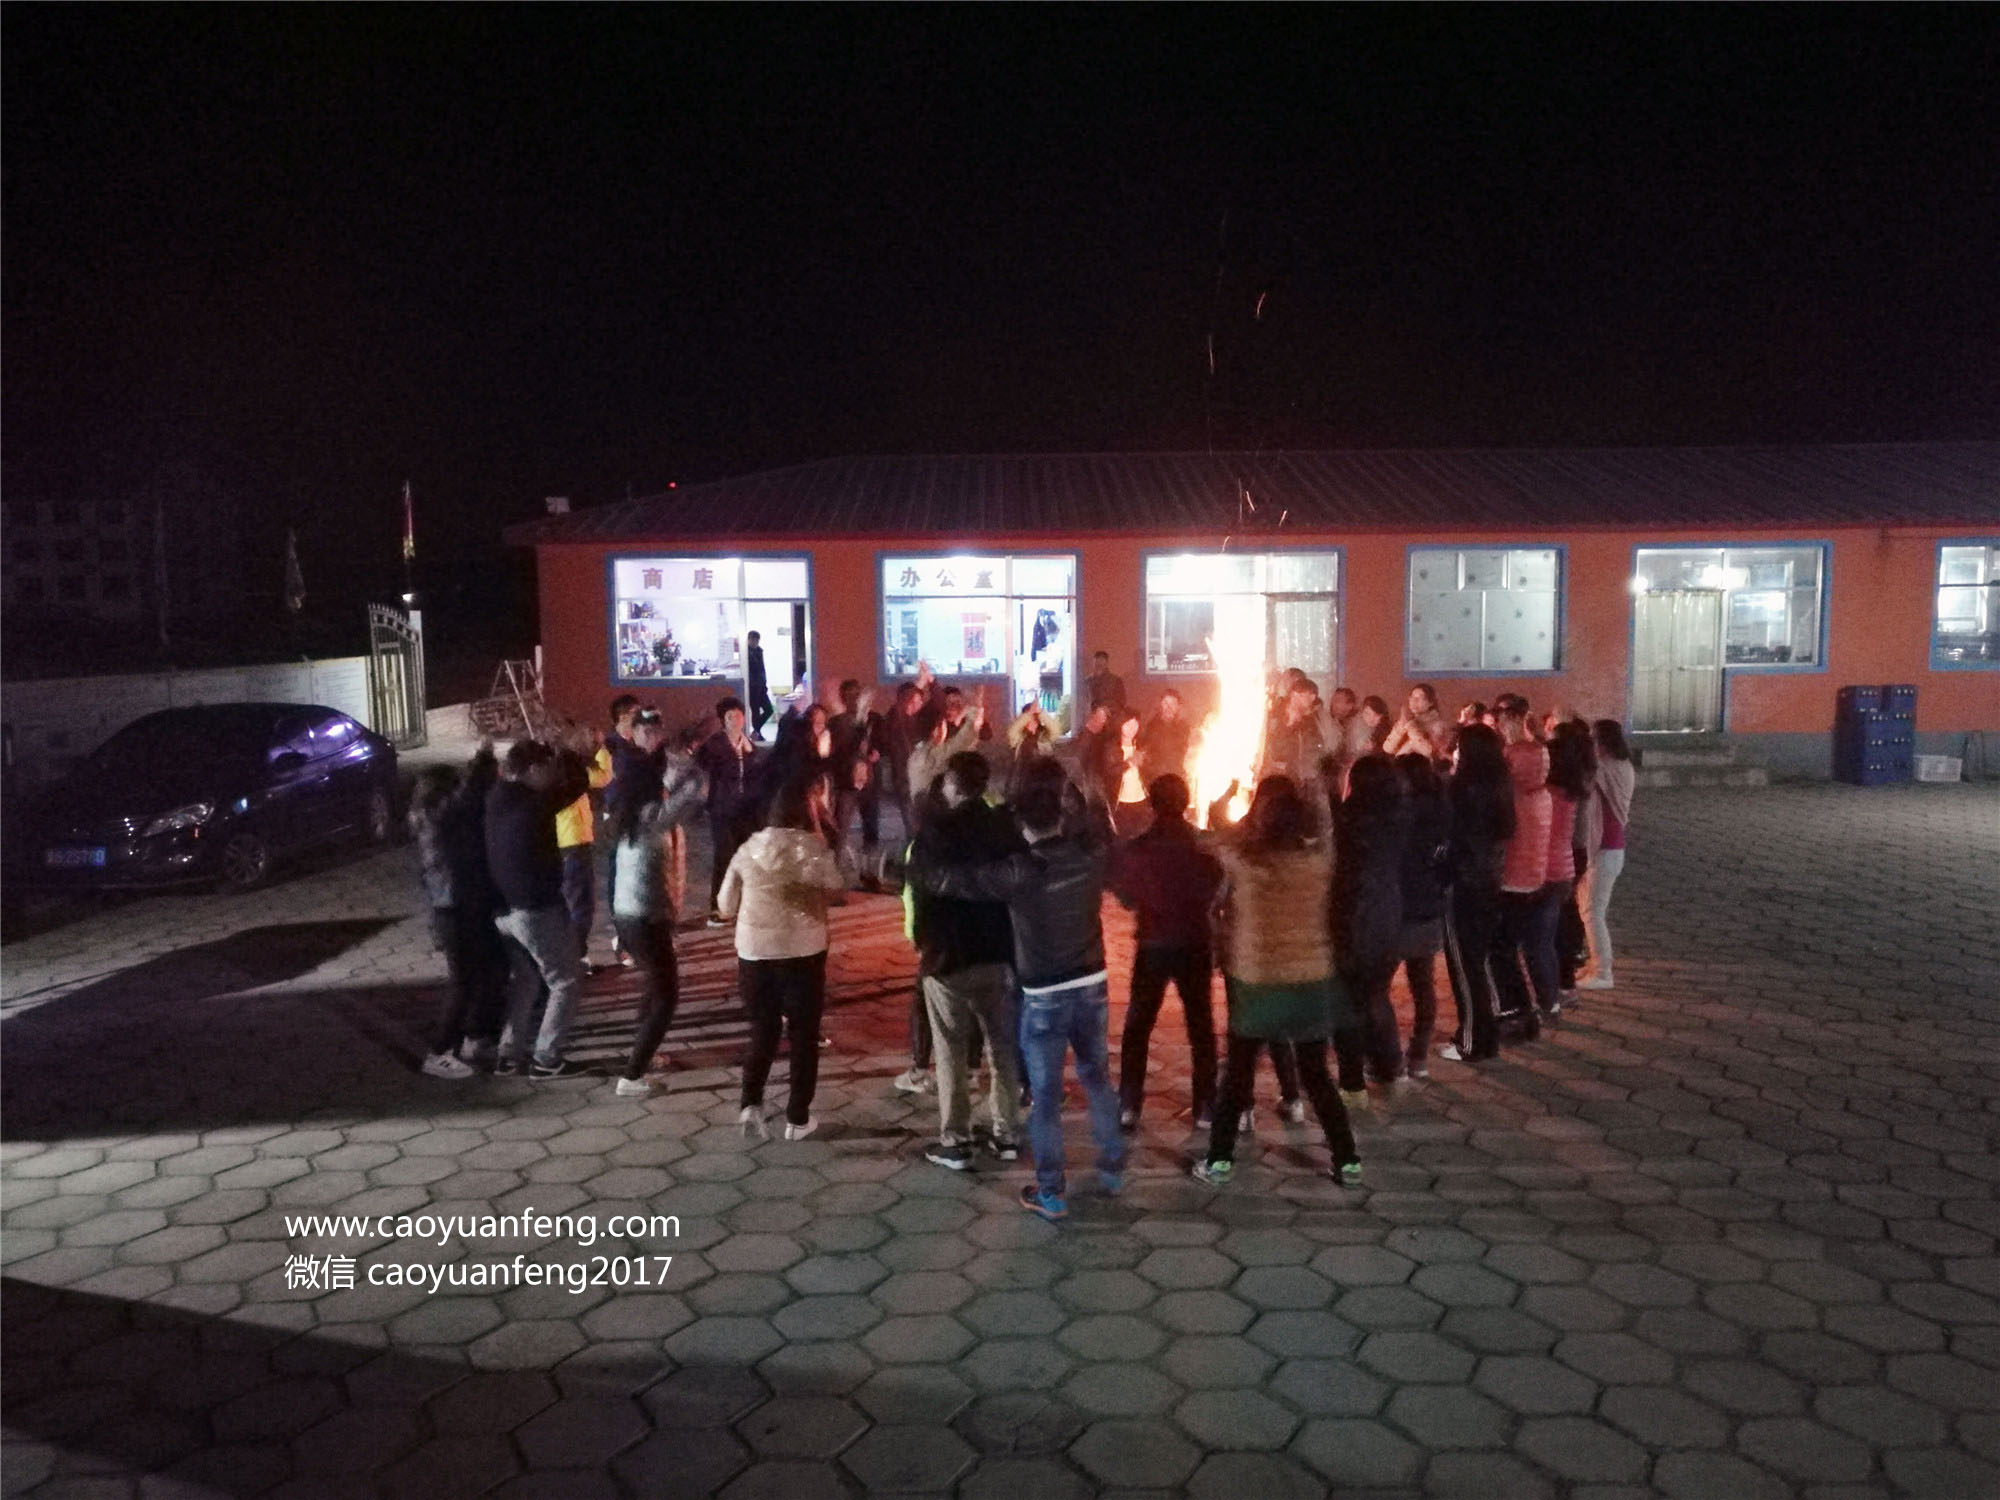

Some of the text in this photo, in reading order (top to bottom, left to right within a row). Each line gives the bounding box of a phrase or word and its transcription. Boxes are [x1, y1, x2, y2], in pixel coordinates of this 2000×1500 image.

[642, 568, 713, 590] 商店
[900, 567, 993, 589] 办公室
